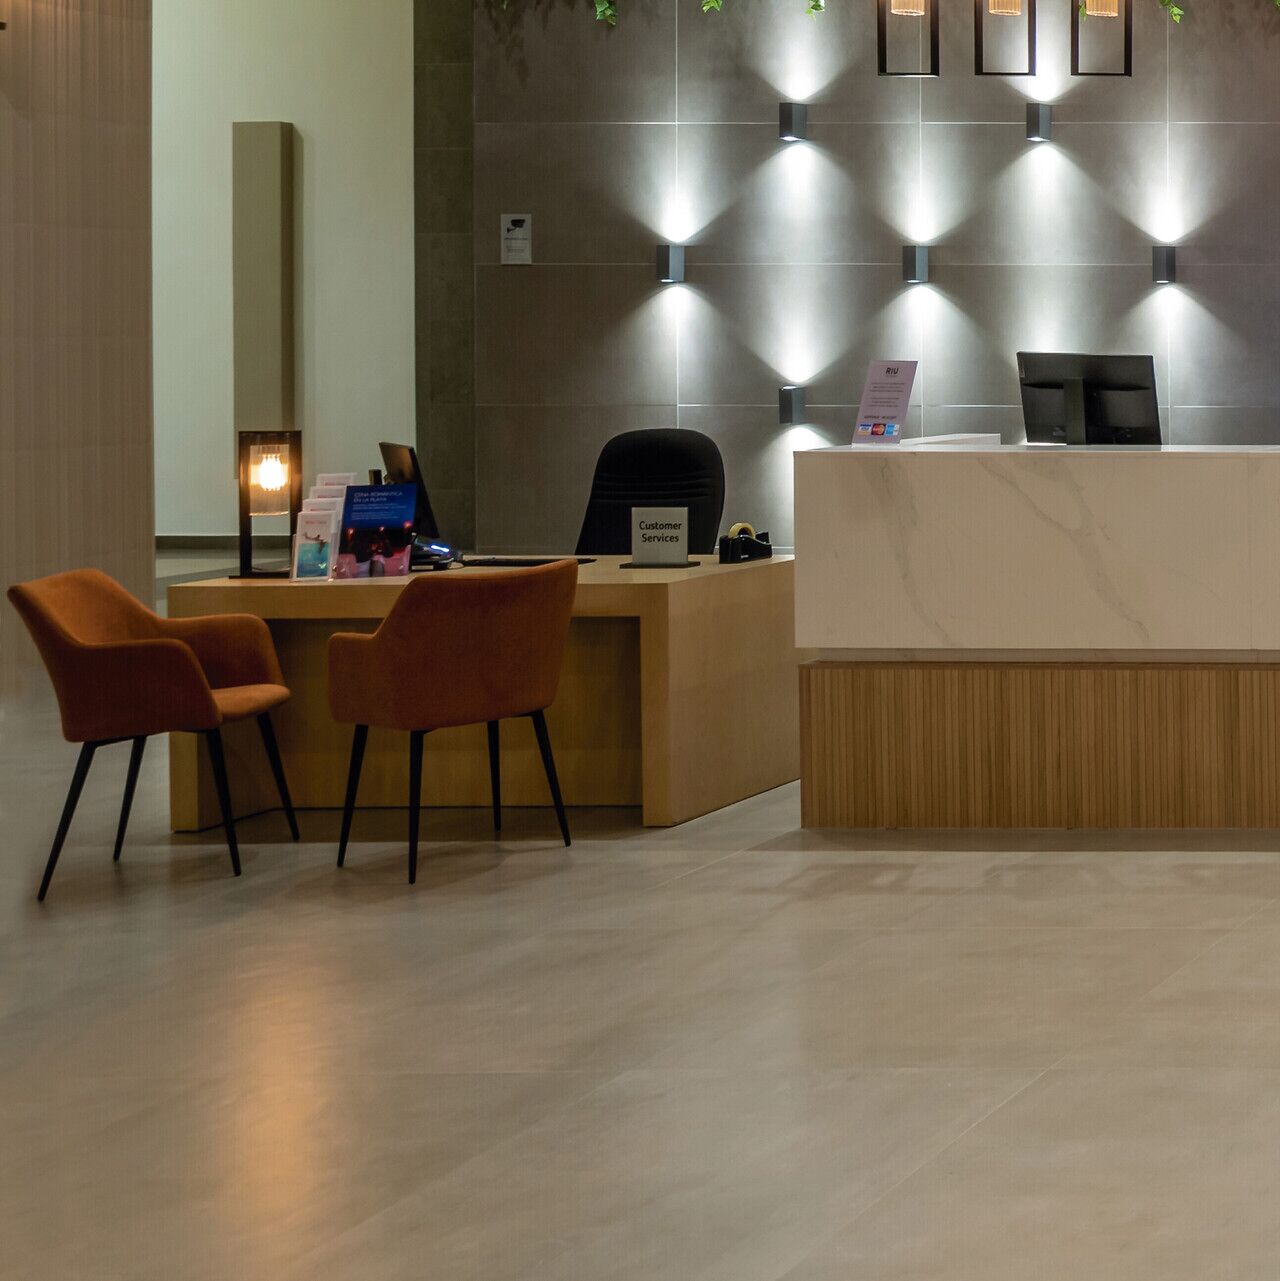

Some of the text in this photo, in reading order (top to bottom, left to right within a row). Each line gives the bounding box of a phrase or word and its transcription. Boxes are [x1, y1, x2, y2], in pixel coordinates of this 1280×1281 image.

[886, 367, 899, 375] RIU
[639, 521, 682, 531] Customer
[641, 533, 680, 543] Services
